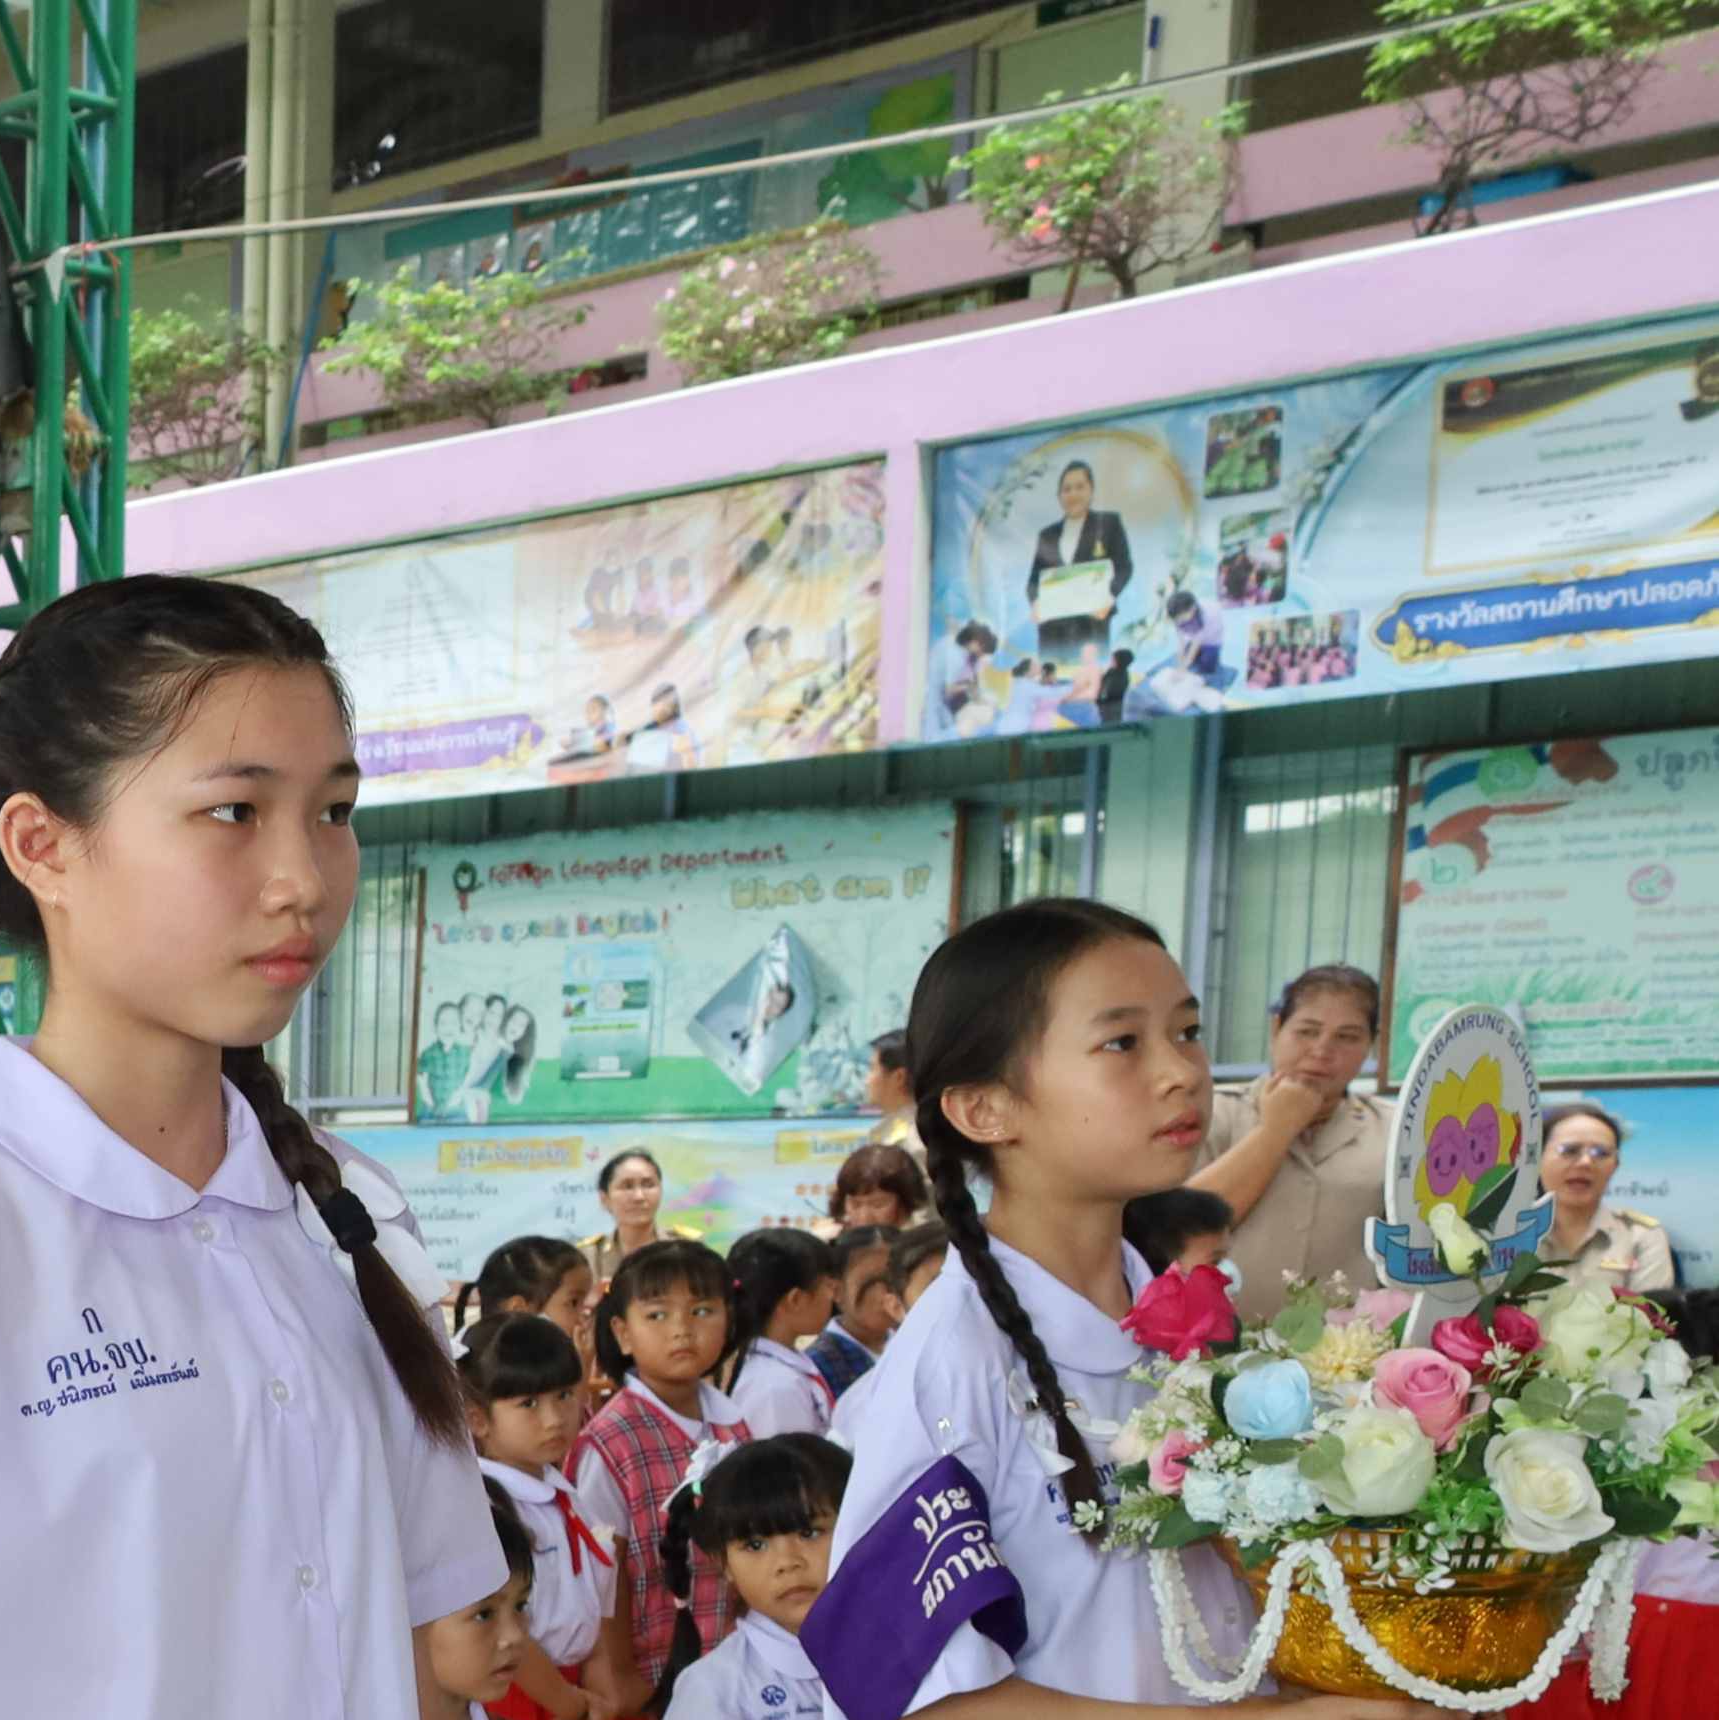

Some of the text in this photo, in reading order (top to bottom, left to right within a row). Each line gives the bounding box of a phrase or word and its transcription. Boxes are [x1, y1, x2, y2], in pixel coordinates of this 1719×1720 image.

[1403, 1012, 1505, 1138] JINDABAMRUNG
[1507, 1030, 1540, 1129] SCHOOL
[81, 1306, 104, 1335] ก
[912, 1485, 972, 1544] ประ
